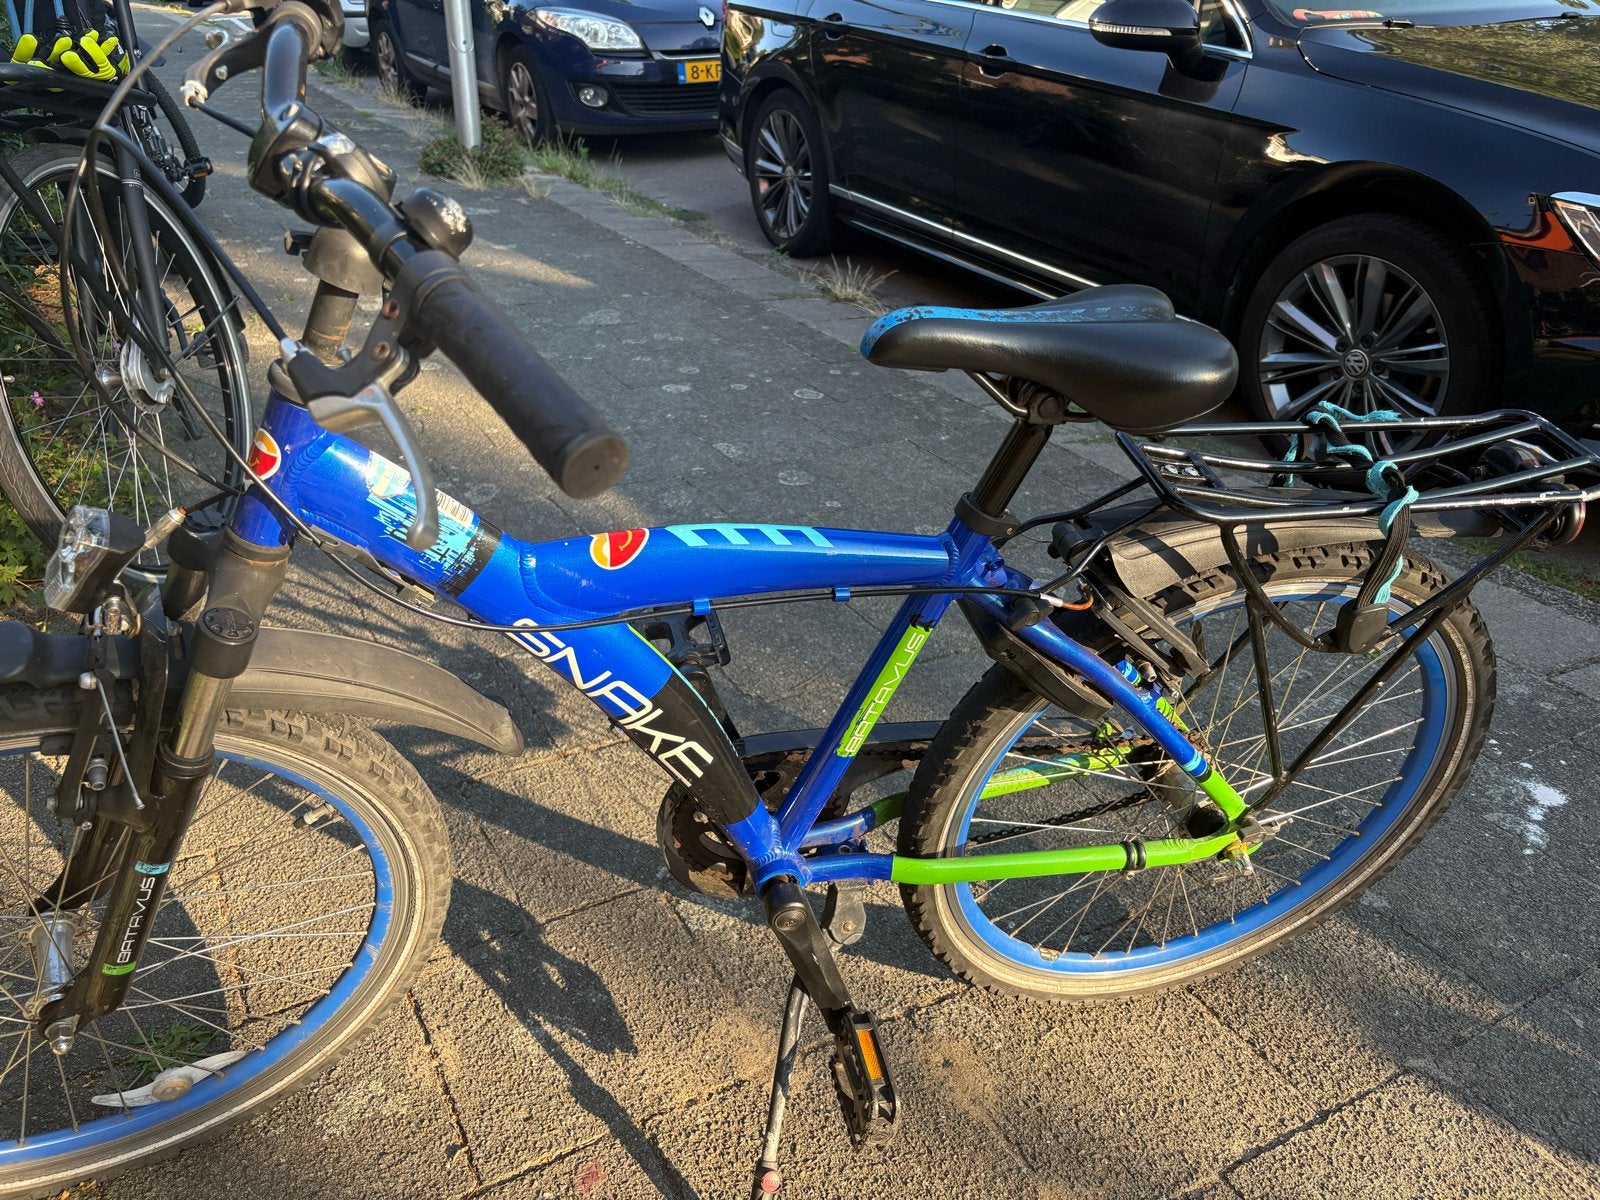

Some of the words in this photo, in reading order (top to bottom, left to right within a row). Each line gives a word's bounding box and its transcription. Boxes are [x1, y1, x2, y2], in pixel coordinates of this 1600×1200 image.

[502, 618, 714, 788] SNAKE
[844, 632, 925, 753] BATAVUS
[116, 876, 156, 963] BATAVUS
